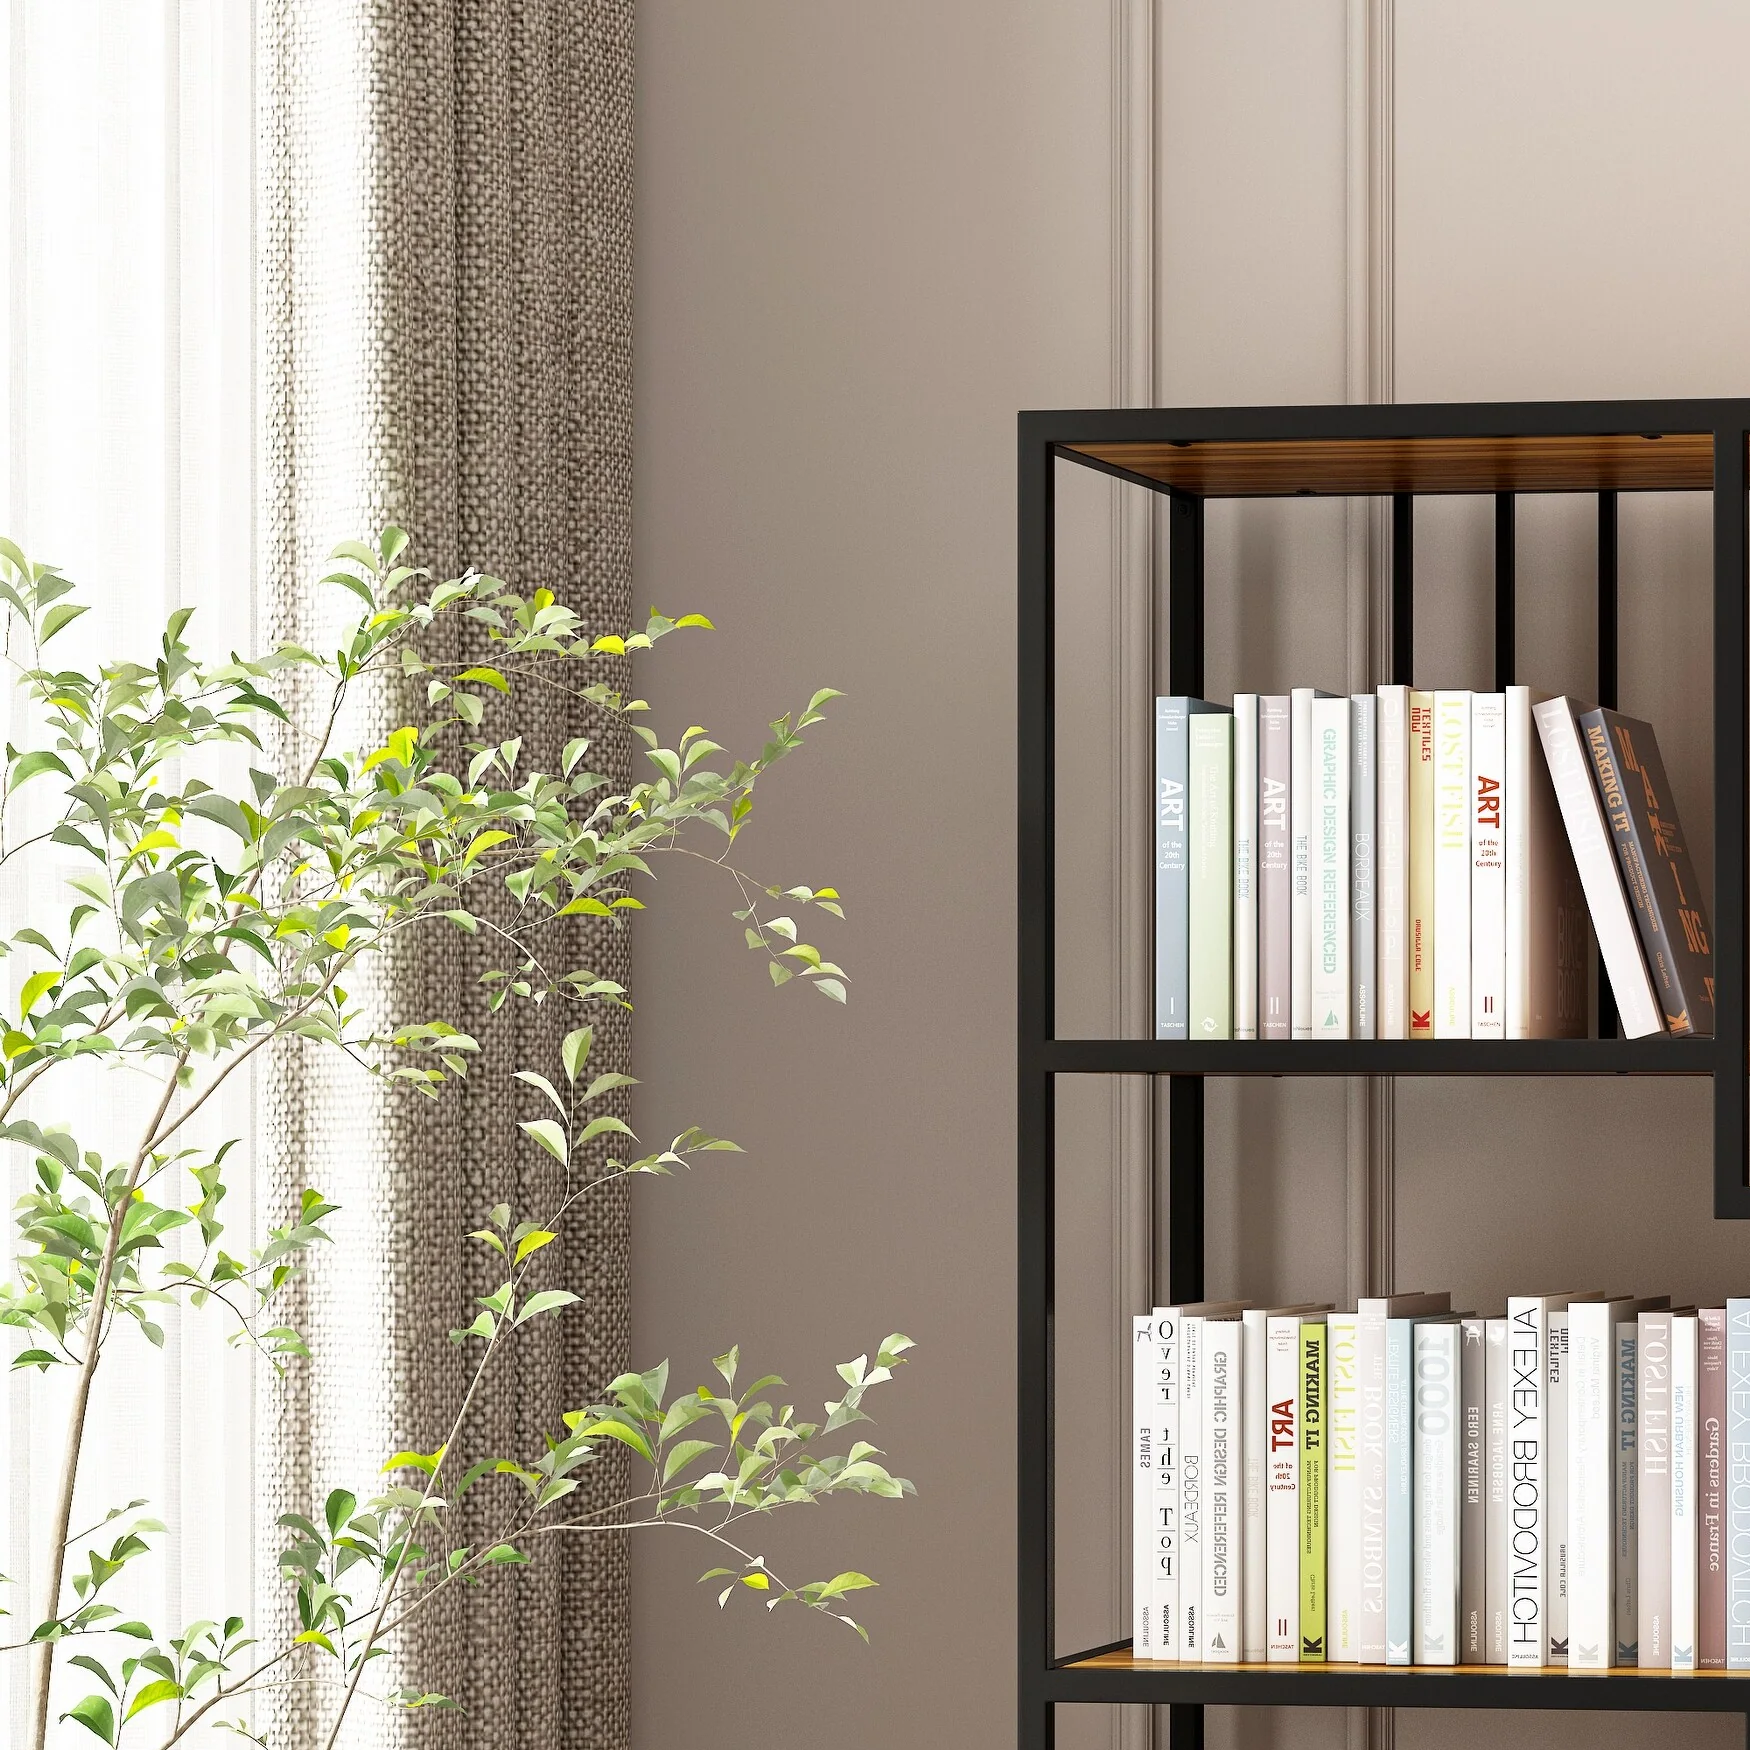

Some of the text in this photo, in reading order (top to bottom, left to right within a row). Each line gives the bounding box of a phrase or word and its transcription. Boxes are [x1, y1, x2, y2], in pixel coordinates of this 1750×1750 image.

[1422, 707, 1431, 761] TEXTILES
[1161, 778, 1183, 831] ART
[1263, 778, 1286, 830] ART
[1478, 776, 1500, 828] ART
[1586, 726, 1630, 832] MAKING IT
[1165, 851, 1180, 859] 20th
[1262, 861, 1287, 870] Century
[1267, 851, 1282, 859] 20th
[1356, 833, 1370, 921] BORDEAUX
[1476, 860, 1501, 868] Century
[1624, 856, 1636, 884] PRODUCT
[1632, 886, 1644, 909] DESIGN
[1628, 841, 1659, 933] MANUFACTURING TECHNIQUES
[1656, 951, 1664, 965] Chris
